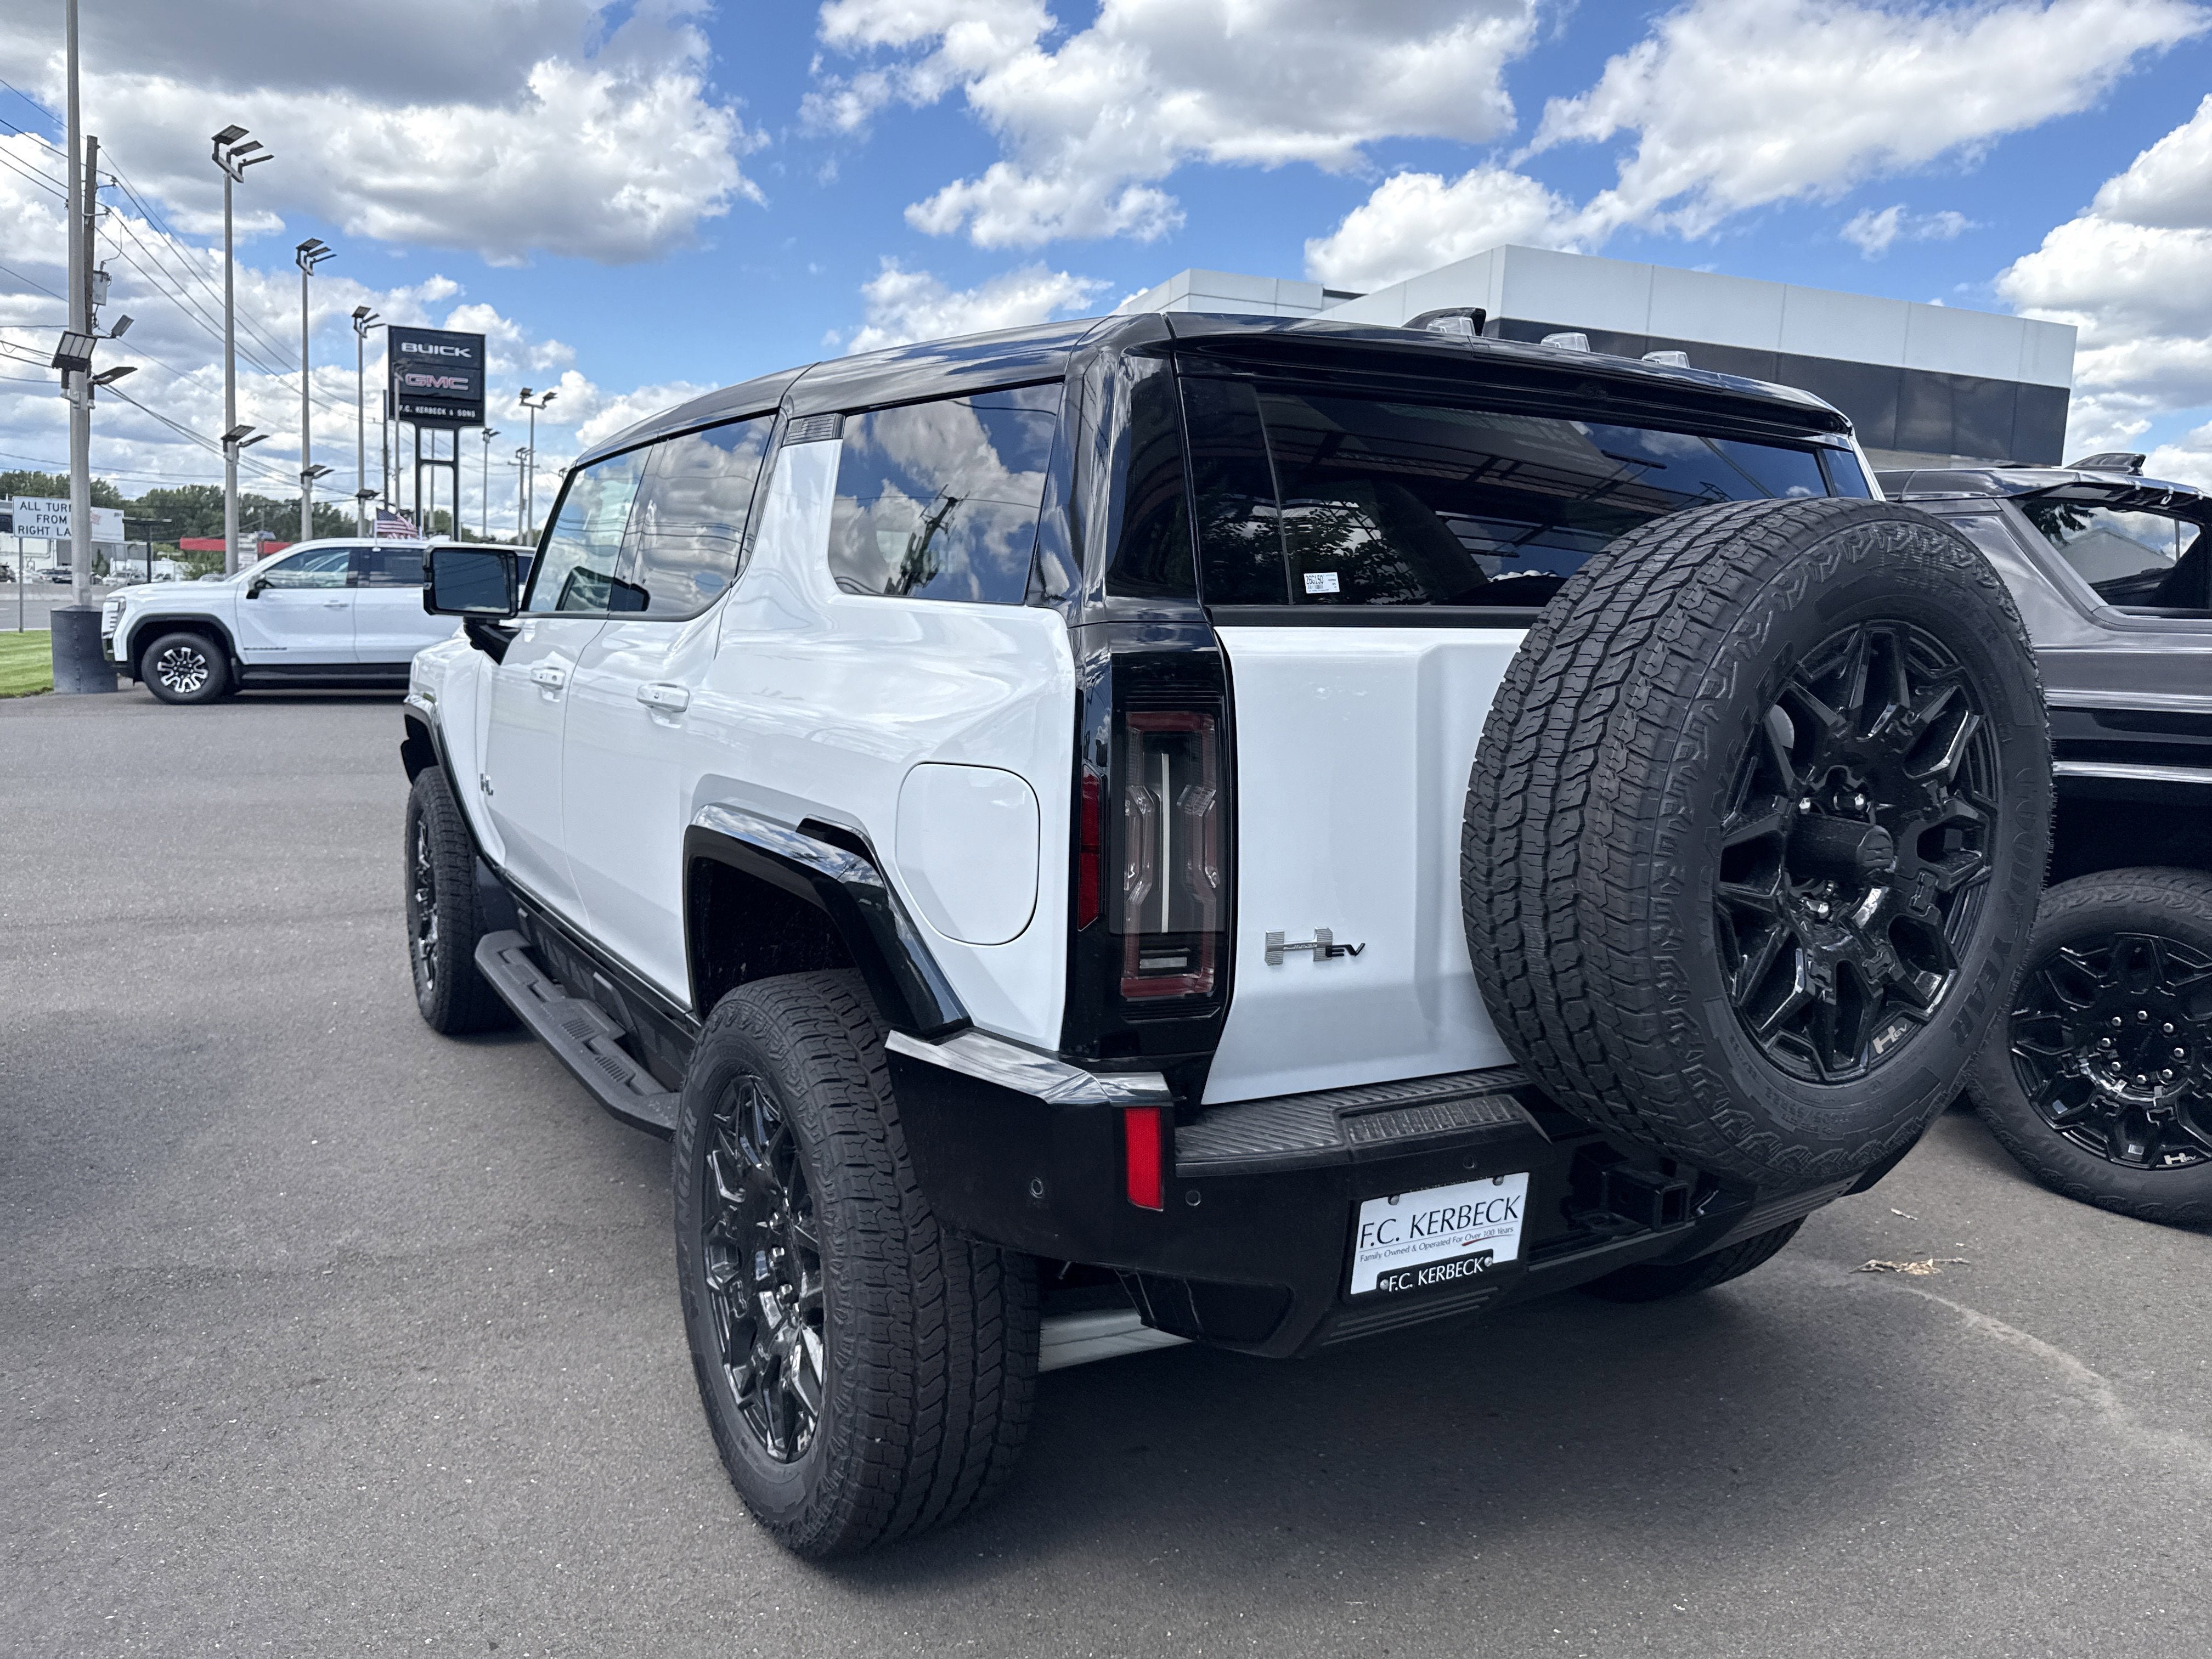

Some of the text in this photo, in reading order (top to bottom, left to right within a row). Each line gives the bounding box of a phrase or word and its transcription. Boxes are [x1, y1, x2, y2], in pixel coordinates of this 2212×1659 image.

[401, 342, 472, 358] BUICK
[405, 373, 469, 391] GMC
[415, 406, 447, 415] KERBECK
[457, 409, 476, 417] SONS
[20, 501, 41, 511] ALL
[36, 514, 67, 524] FROM
[18, 525, 50, 535] RIGHT
[1360, 1195, 1521, 1248] F.C. KERBECK
[1360, 1251, 1383, 1262] Family
[1384, 1245, 1410, 1257] Owned
[1419, 1237, 1451, 1251] Operated
[1483, 1229, 1495, 1237] 100
[1389, 1256, 1484, 1293] F.C. KERBECK
